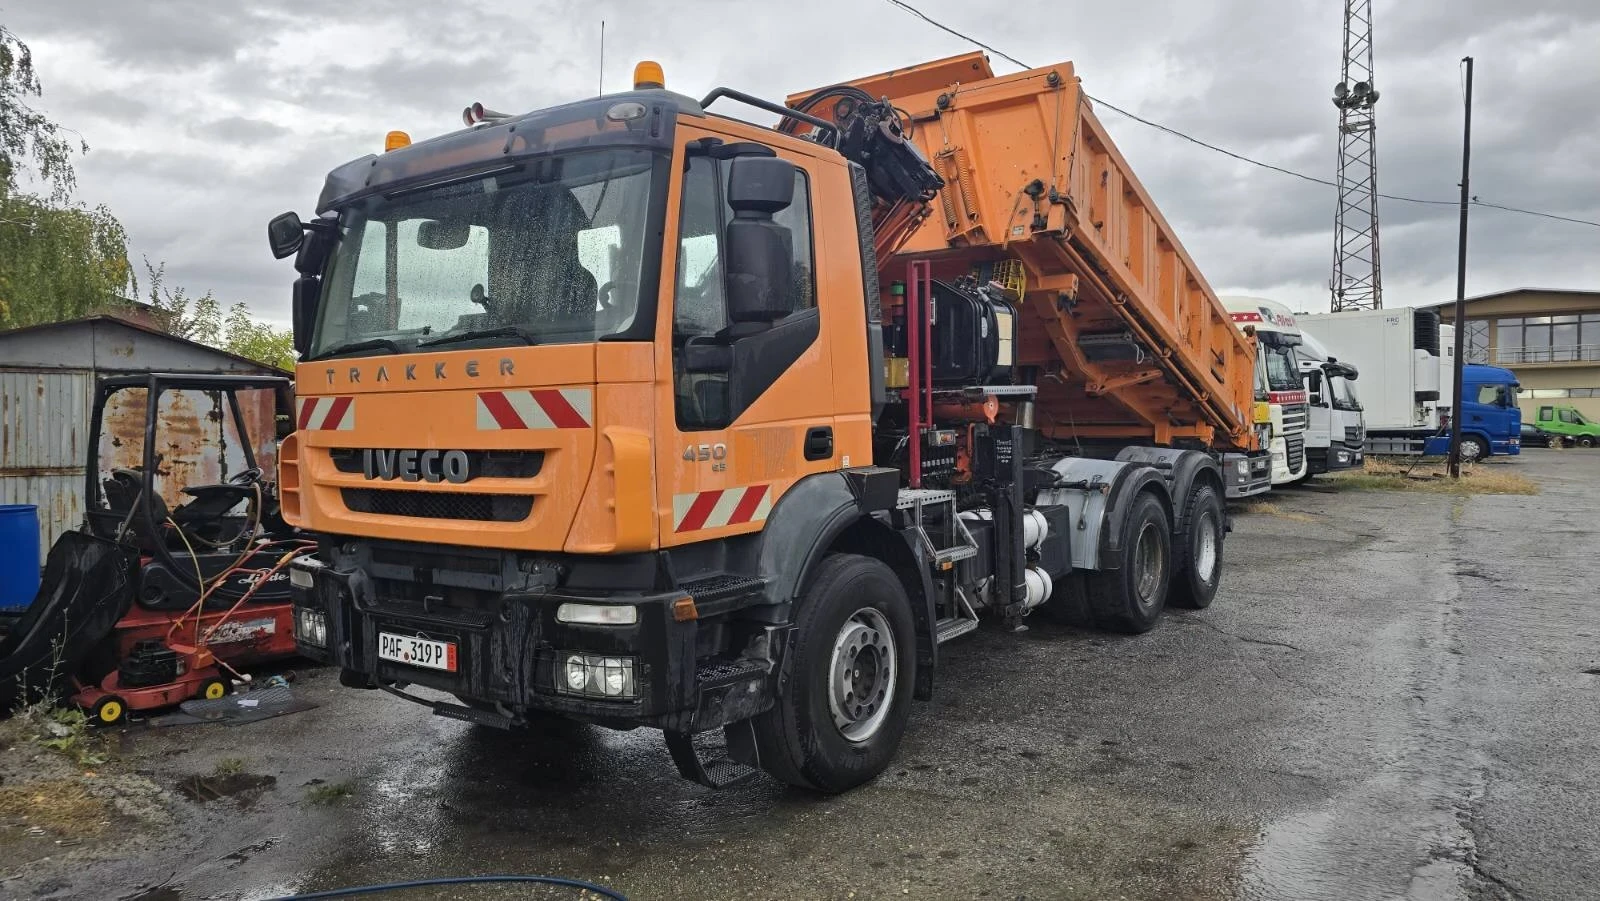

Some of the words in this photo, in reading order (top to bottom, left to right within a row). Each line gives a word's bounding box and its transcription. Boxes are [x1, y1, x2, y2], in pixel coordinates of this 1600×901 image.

[325, 358, 515, 384] TRAKKER
[682, 443, 727, 462] 450
[363, 449, 471, 483] IVECO
[238, 572, 290, 584] Lide
[382, 636, 402, 657] PAF
